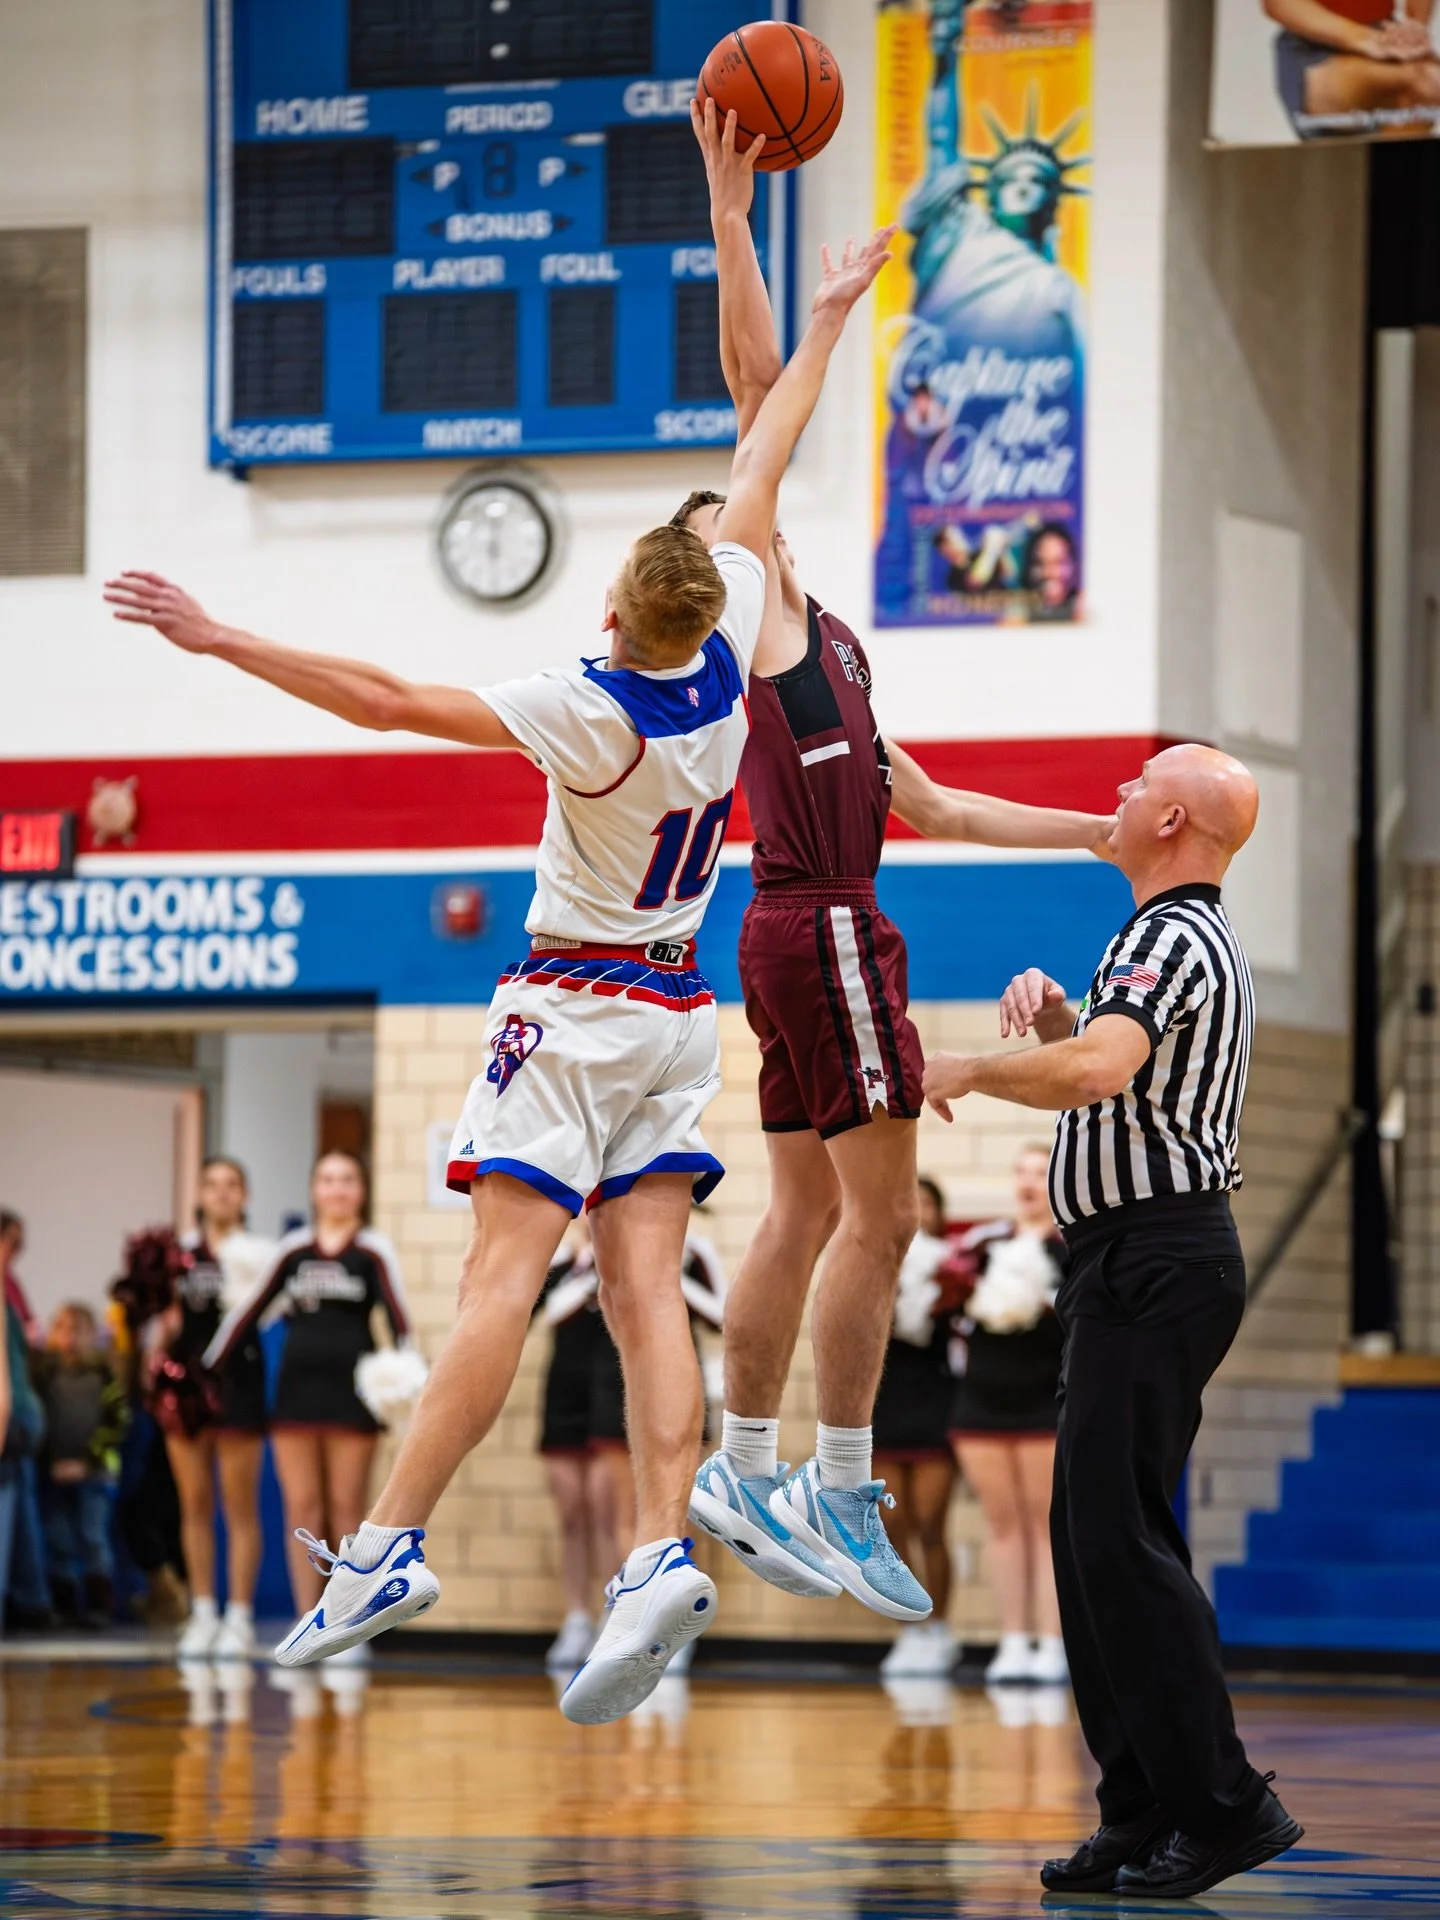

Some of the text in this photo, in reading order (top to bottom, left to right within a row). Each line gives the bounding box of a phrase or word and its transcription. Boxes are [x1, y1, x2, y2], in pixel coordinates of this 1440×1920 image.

[256, 96, 369, 135] HOME
[622, 78, 697, 118] GUE
[445, 101, 553, 134] PERIOD
[433, 161, 460, 191] P
[538, 157, 566, 187] P
[446, 210, 552, 243] BONUS
[392, 255, 506, 290] PLAYER
[540, 252, 622, 283] FOUL
[881, 315, 1074, 426] Capture
[653, 407, 738, 443] SCOR
[998, 384, 1070, 447] the
[228, 422, 335, 458] SCORE
[924, 416, 1075, 514] Spirit
[633, 787, 733, 910] 10
[0, 877, 304, 935] ESTROOMS &
[0, 931, 298, 992] ONCESSIONS
